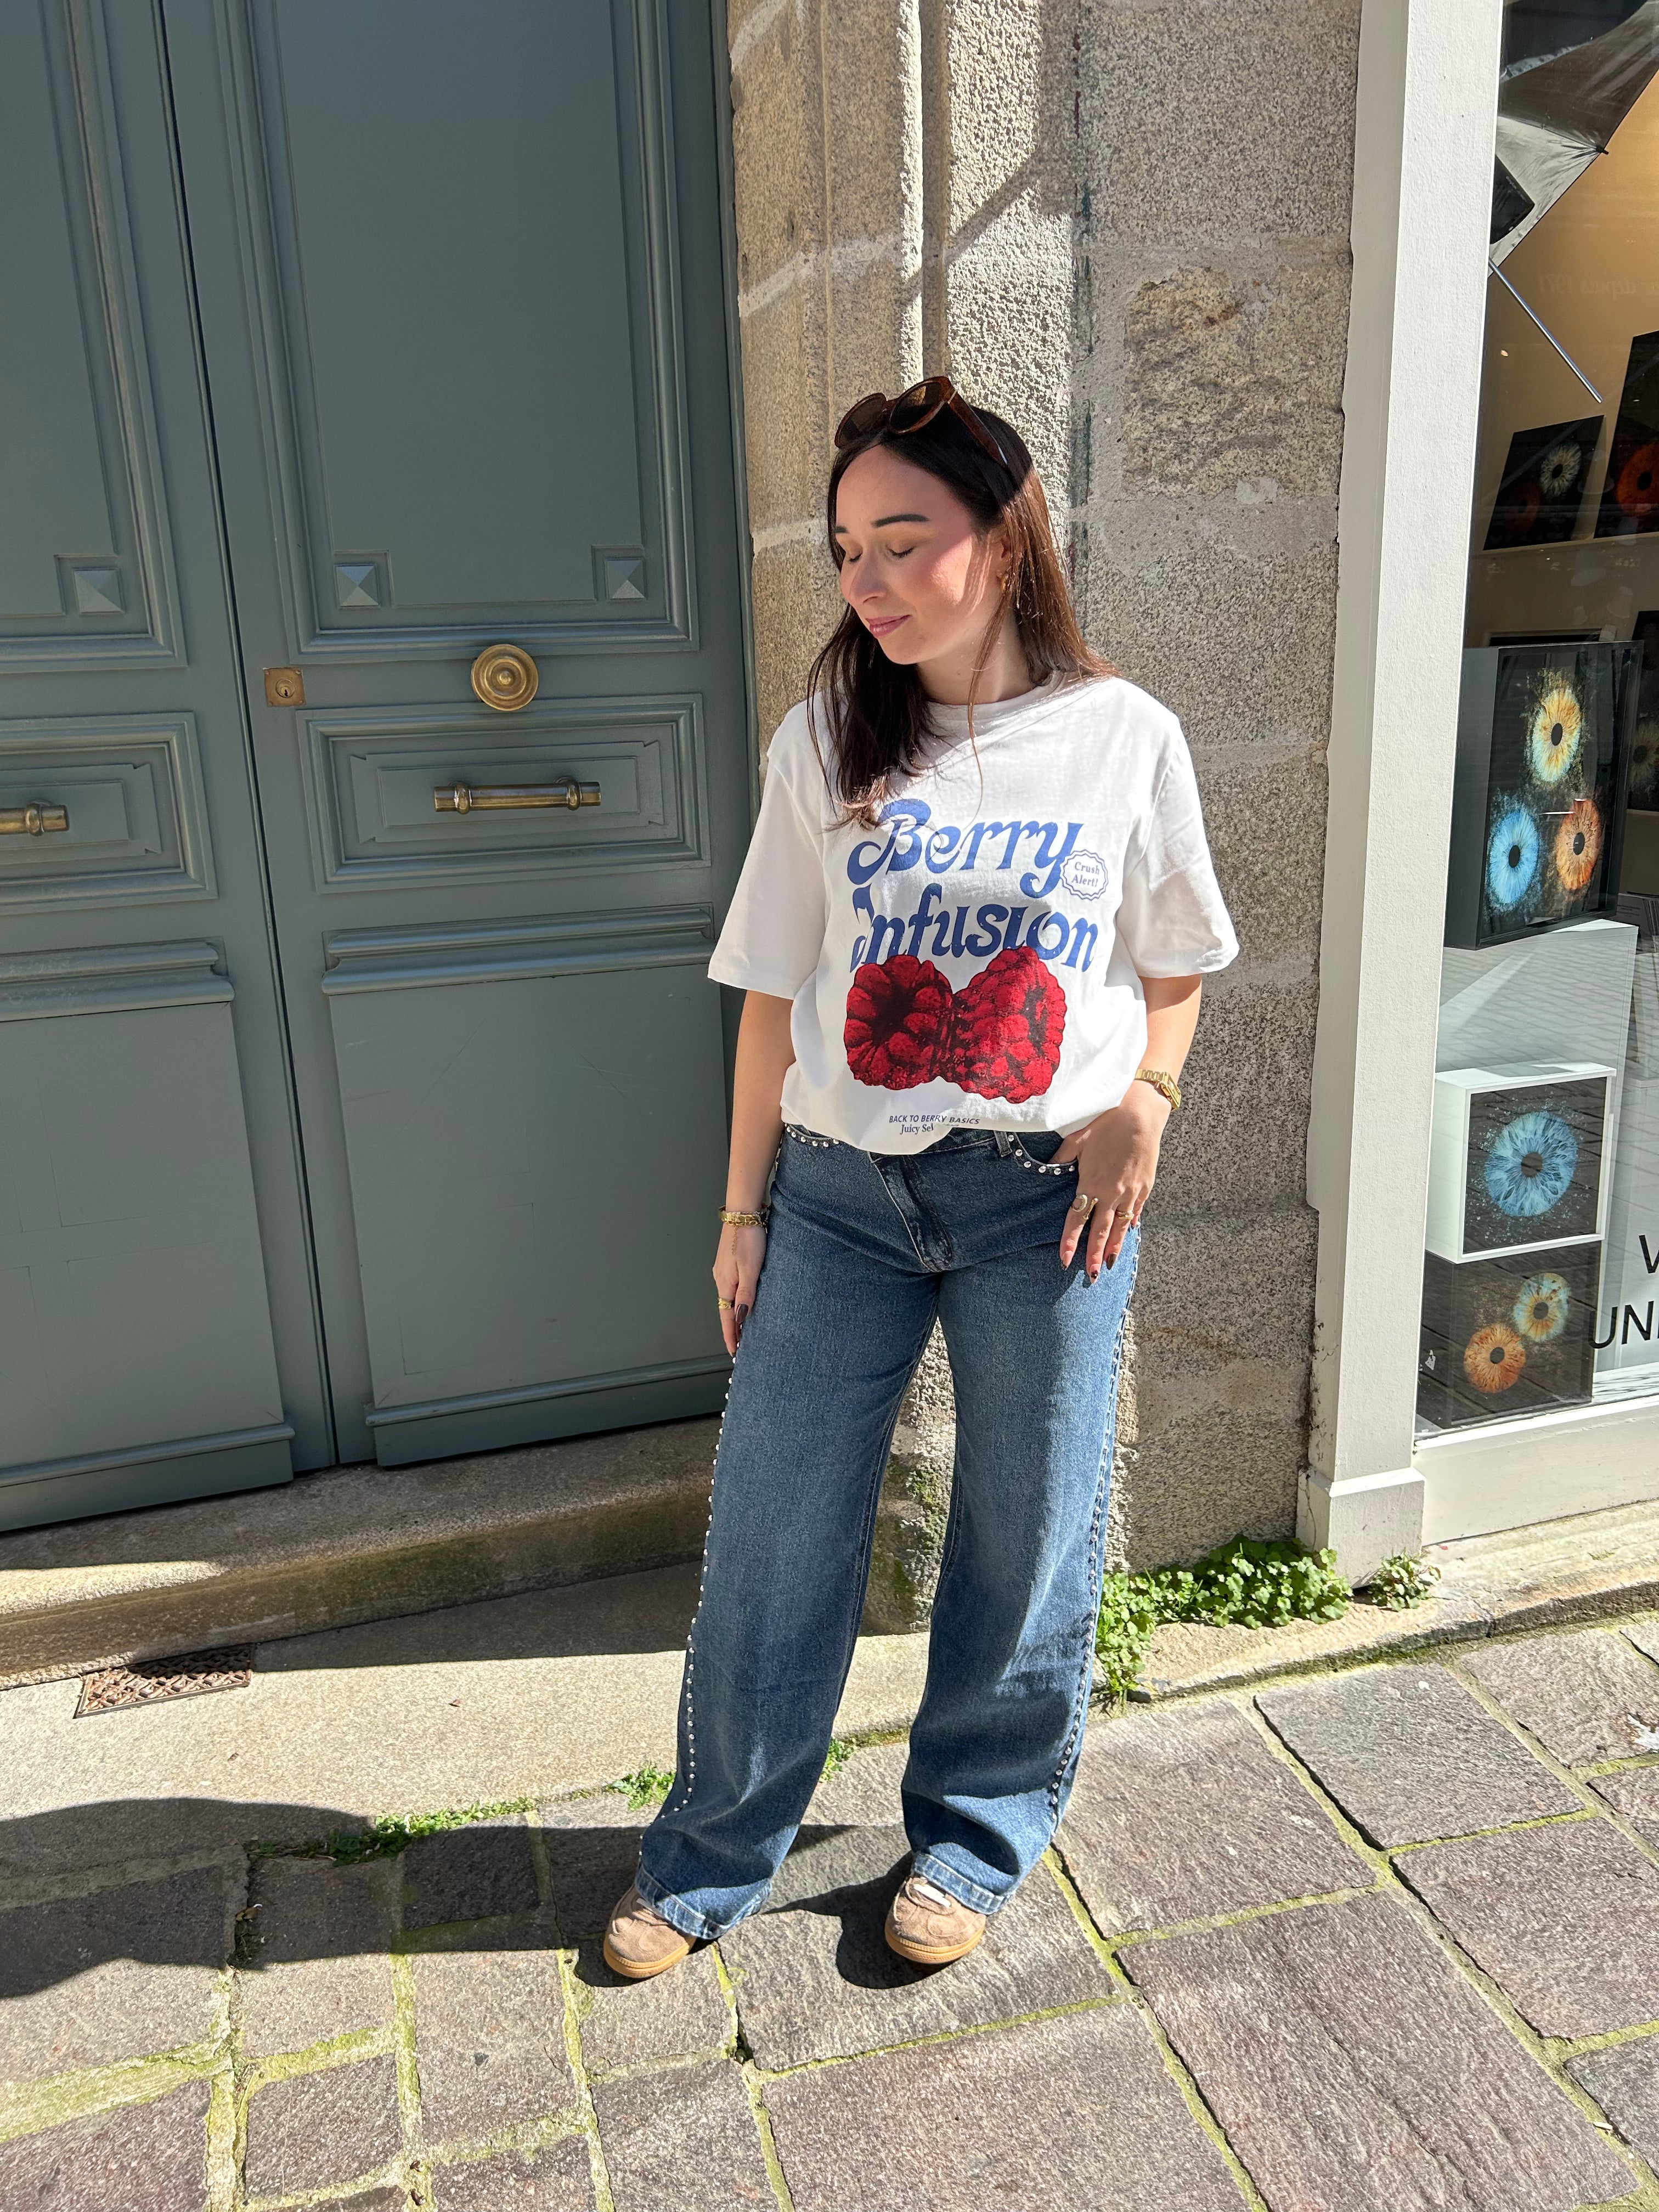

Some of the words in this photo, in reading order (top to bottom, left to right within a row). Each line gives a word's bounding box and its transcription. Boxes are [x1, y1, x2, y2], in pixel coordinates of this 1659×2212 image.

[847, 798, 1085, 899] Berry
[1074, 861, 1099, 875] Crush
[1071, 874, 1098, 887] Alert!
[850, 883, 1098, 973] Infusion
[889, 1115, 907, 1123] BACK
[900, 1124, 920, 1135] Juicy
[1588, 1301, 1659, 1348] UN
